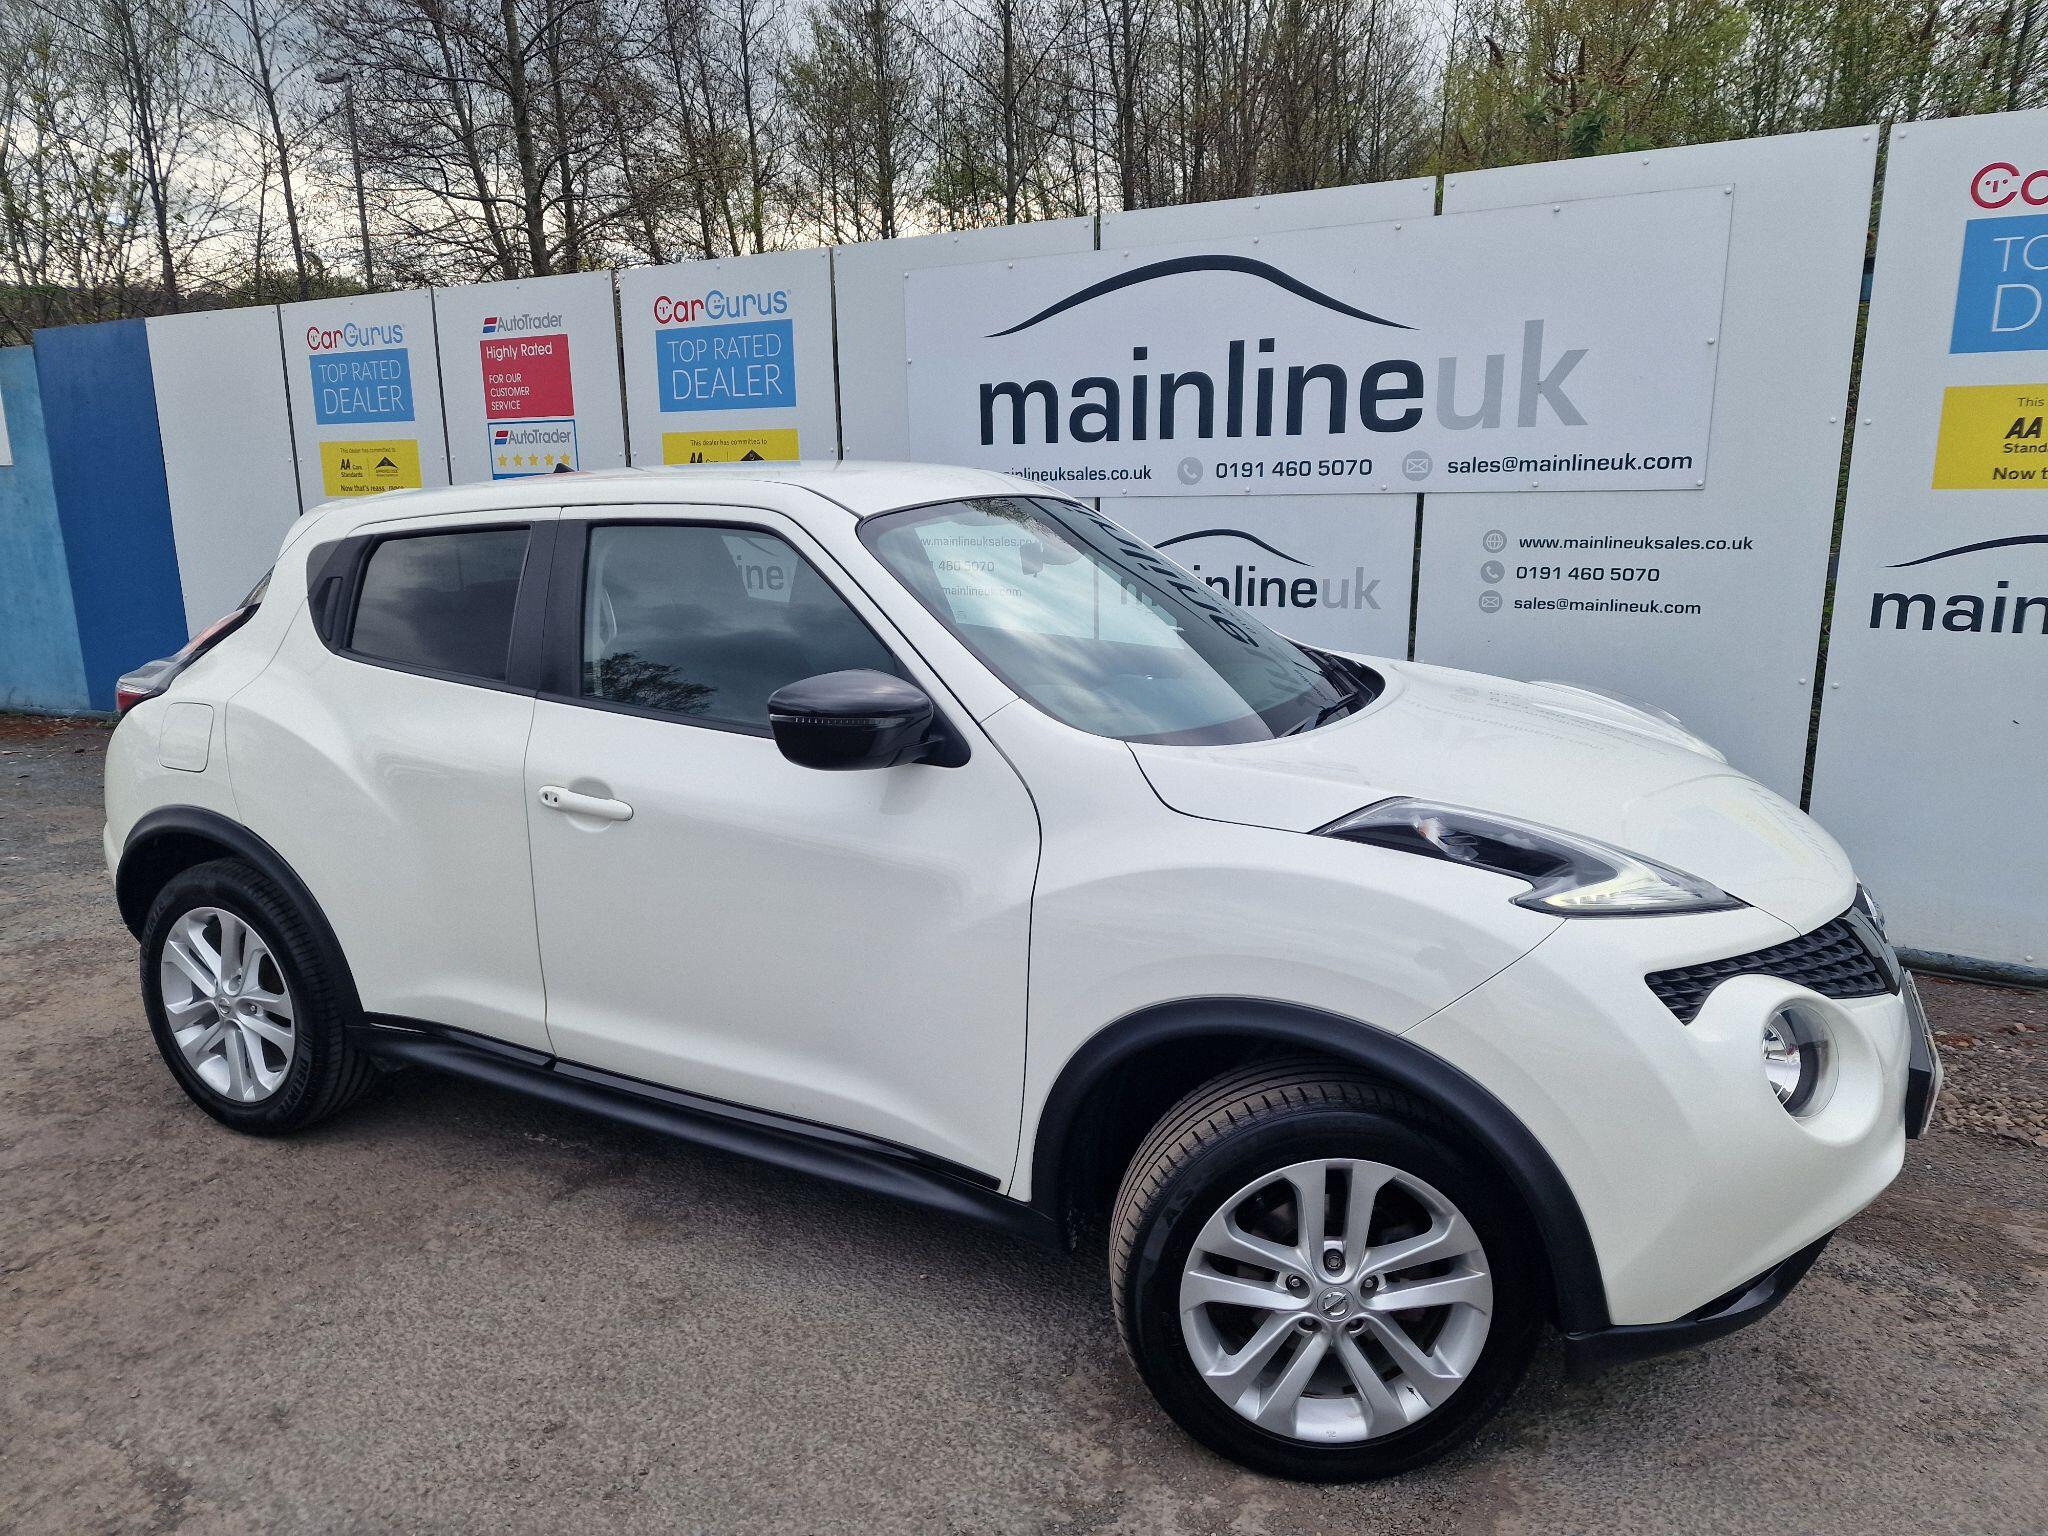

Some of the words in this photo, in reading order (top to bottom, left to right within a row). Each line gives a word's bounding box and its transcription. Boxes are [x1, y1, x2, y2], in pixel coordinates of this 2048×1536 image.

[496, 311, 562, 334] AutoTrader
[486, 344, 518, 362] Highly
[520, 341, 553, 357] Rated
[667, 338, 708, 363] TOP
[713, 333, 782, 360] RATED
[318, 363, 348, 383] TOP
[351, 359, 402, 381] RATED
[488, 373, 504, 384] FOR
[505, 372, 522, 384] OUR
[672, 363, 783, 400] DEALER
[979, 318, 1590, 446] mainlineuk
[323, 385, 406, 415] DEALER
[490, 386, 531, 398] CUSTOMER
[491, 400, 521, 411] SERVICE
[2016, 397, 2045, 407] This
[508, 427, 571, 446] AutoTrader
[2003, 416, 2044, 439] AA
[2003, 442, 2048, 453] Stand
[340, 458, 351, 470] AA
[1215, 460, 1266, 479] 0191
[1271, 459, 1312, 478] 460
[1317, 458, 1373, 477] 5070
[1447, 453, 1693, 475] sales@mainlineuk.com
[1992, 467, 2037, 480] Now
[1518, 535, 1754, 551] www.mainlineuksales.co.uk
[1515, 566, 1562, 580] 0191
[1567, 567, 1605, 581] 460
[1610, 567, 1660, 582] 5070
[1513, 596, 1702, 615] sales@mainlineuk.com
